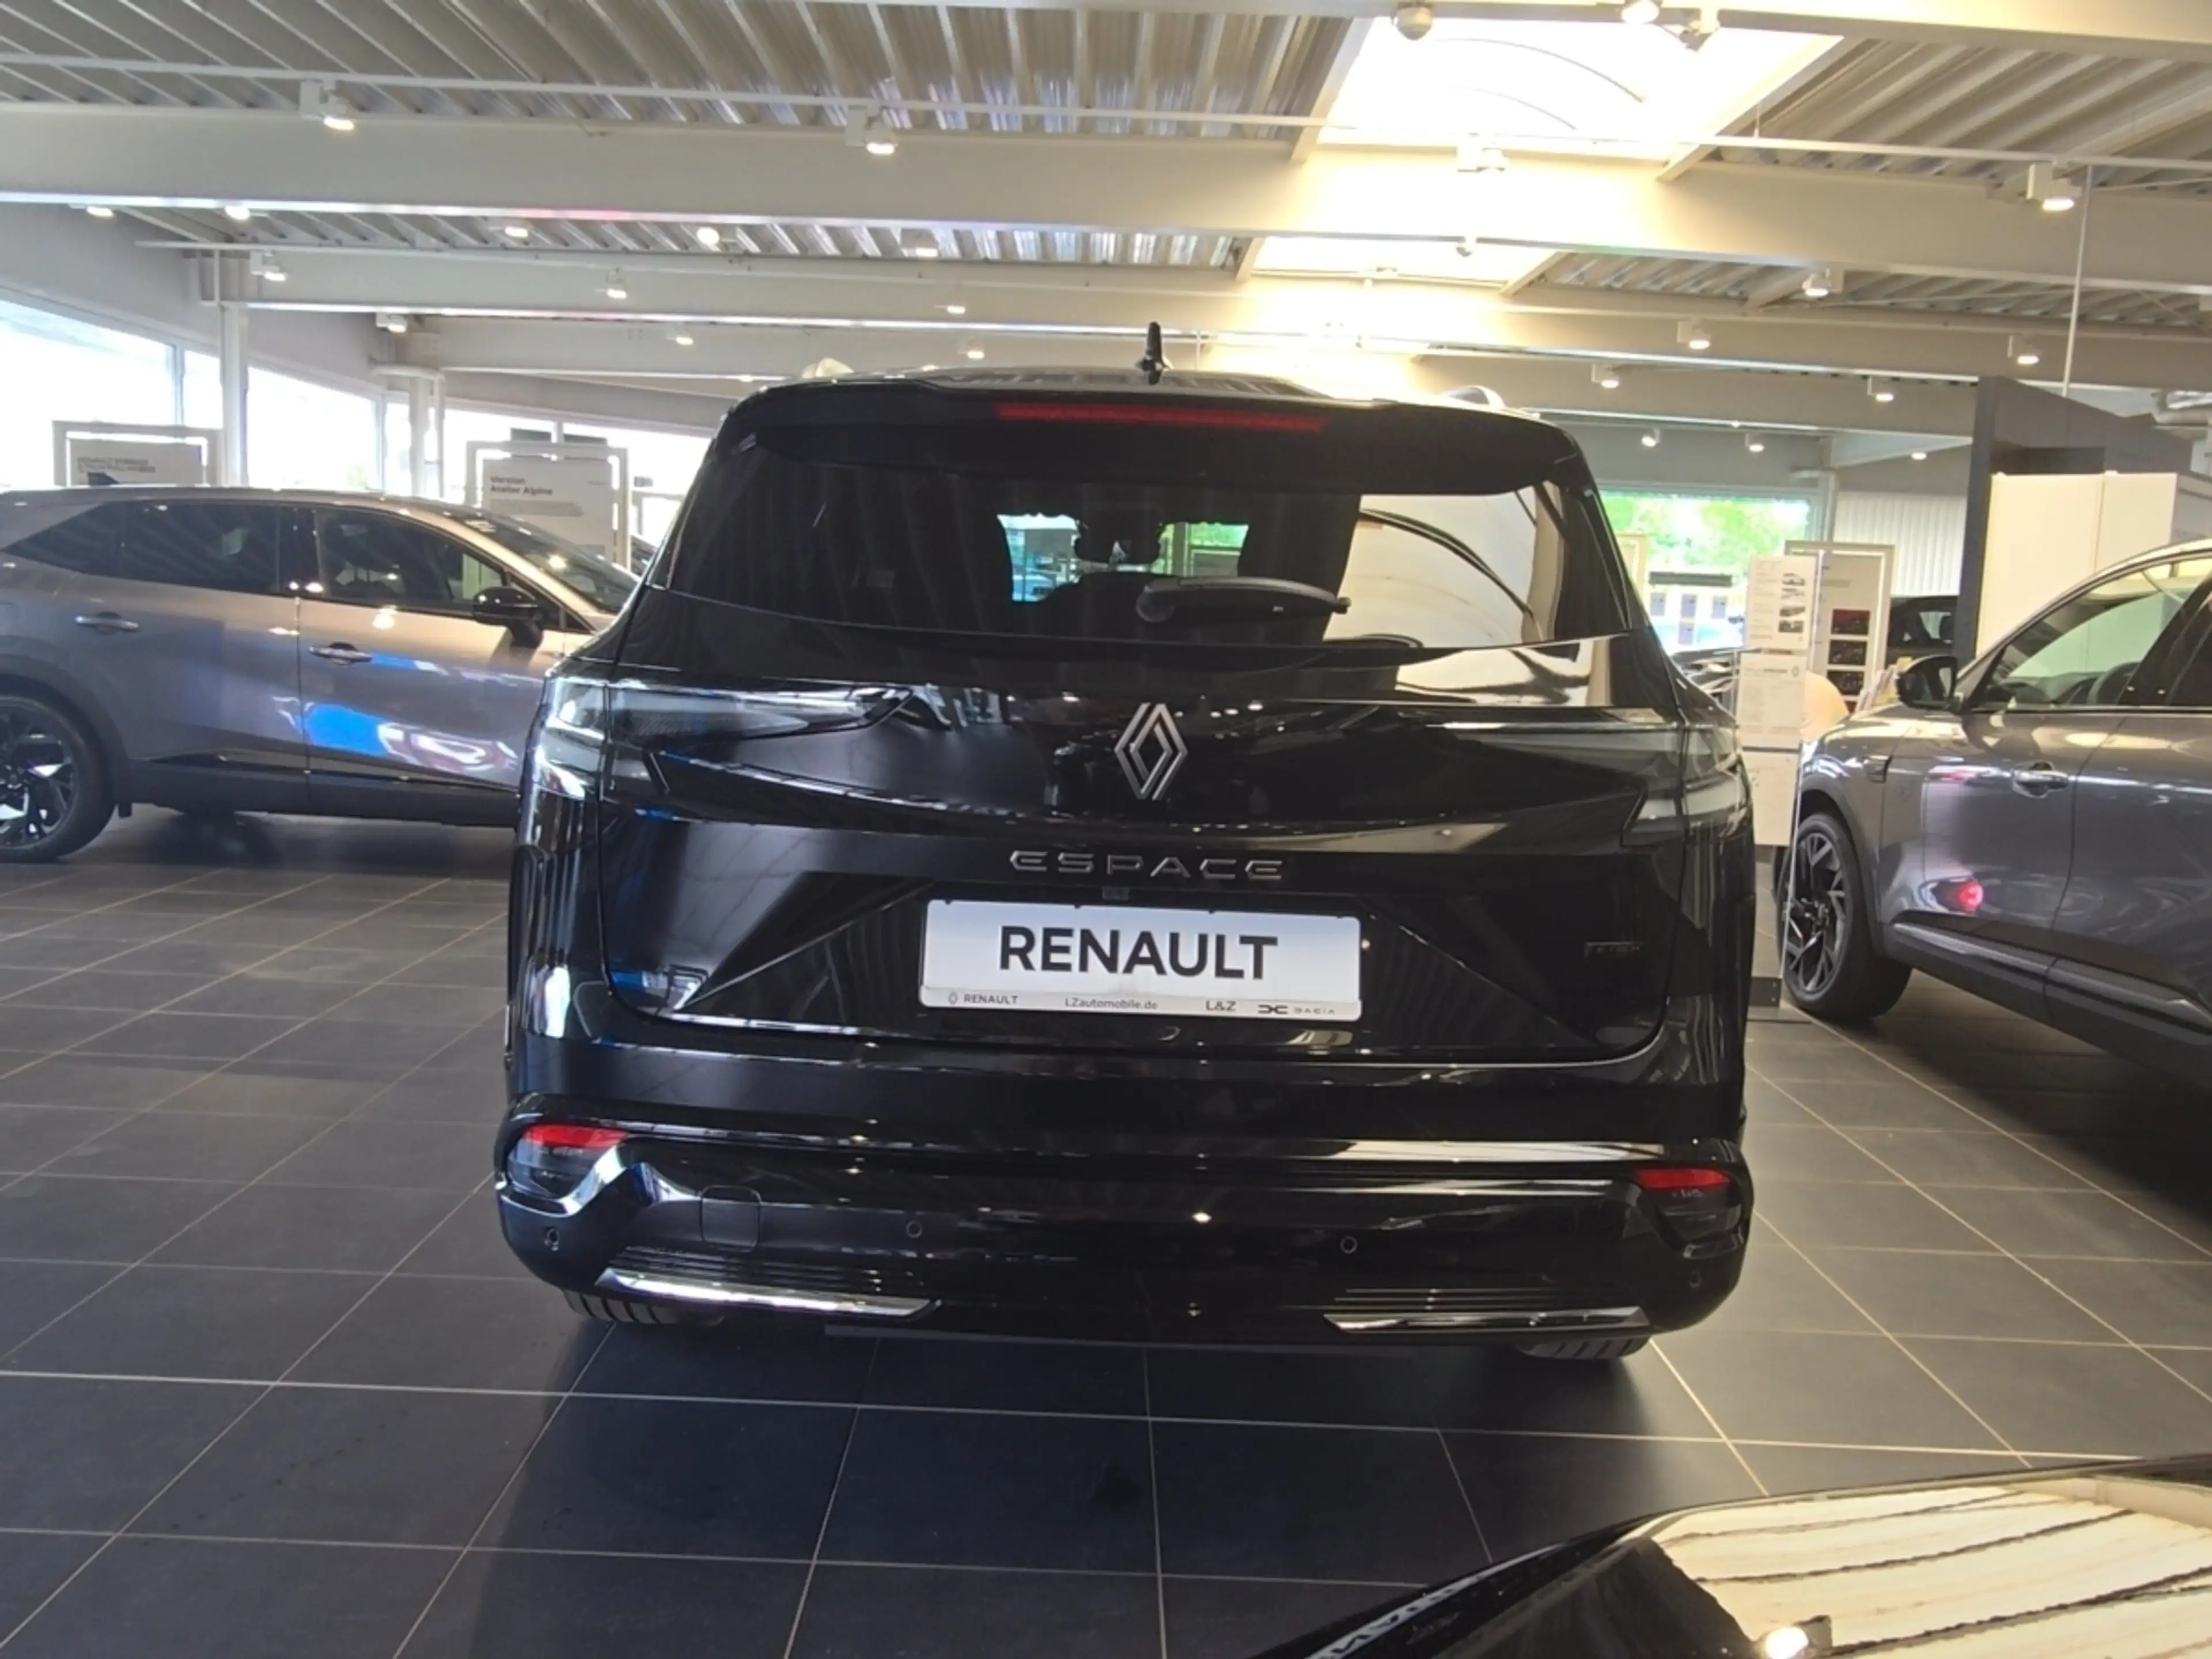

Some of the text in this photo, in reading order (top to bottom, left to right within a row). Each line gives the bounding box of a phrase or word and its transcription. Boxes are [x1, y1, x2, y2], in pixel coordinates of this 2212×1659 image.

[1010, 850, 1282, 881] ESPACE
[999, 925, 1278, 979] RENAULT
[963, 993, 1018, 1005] RENAULT
[1065, 997, 1158, 1010] LZautomobile.de
[1205, 1000, 1236, 1012] L&Z
